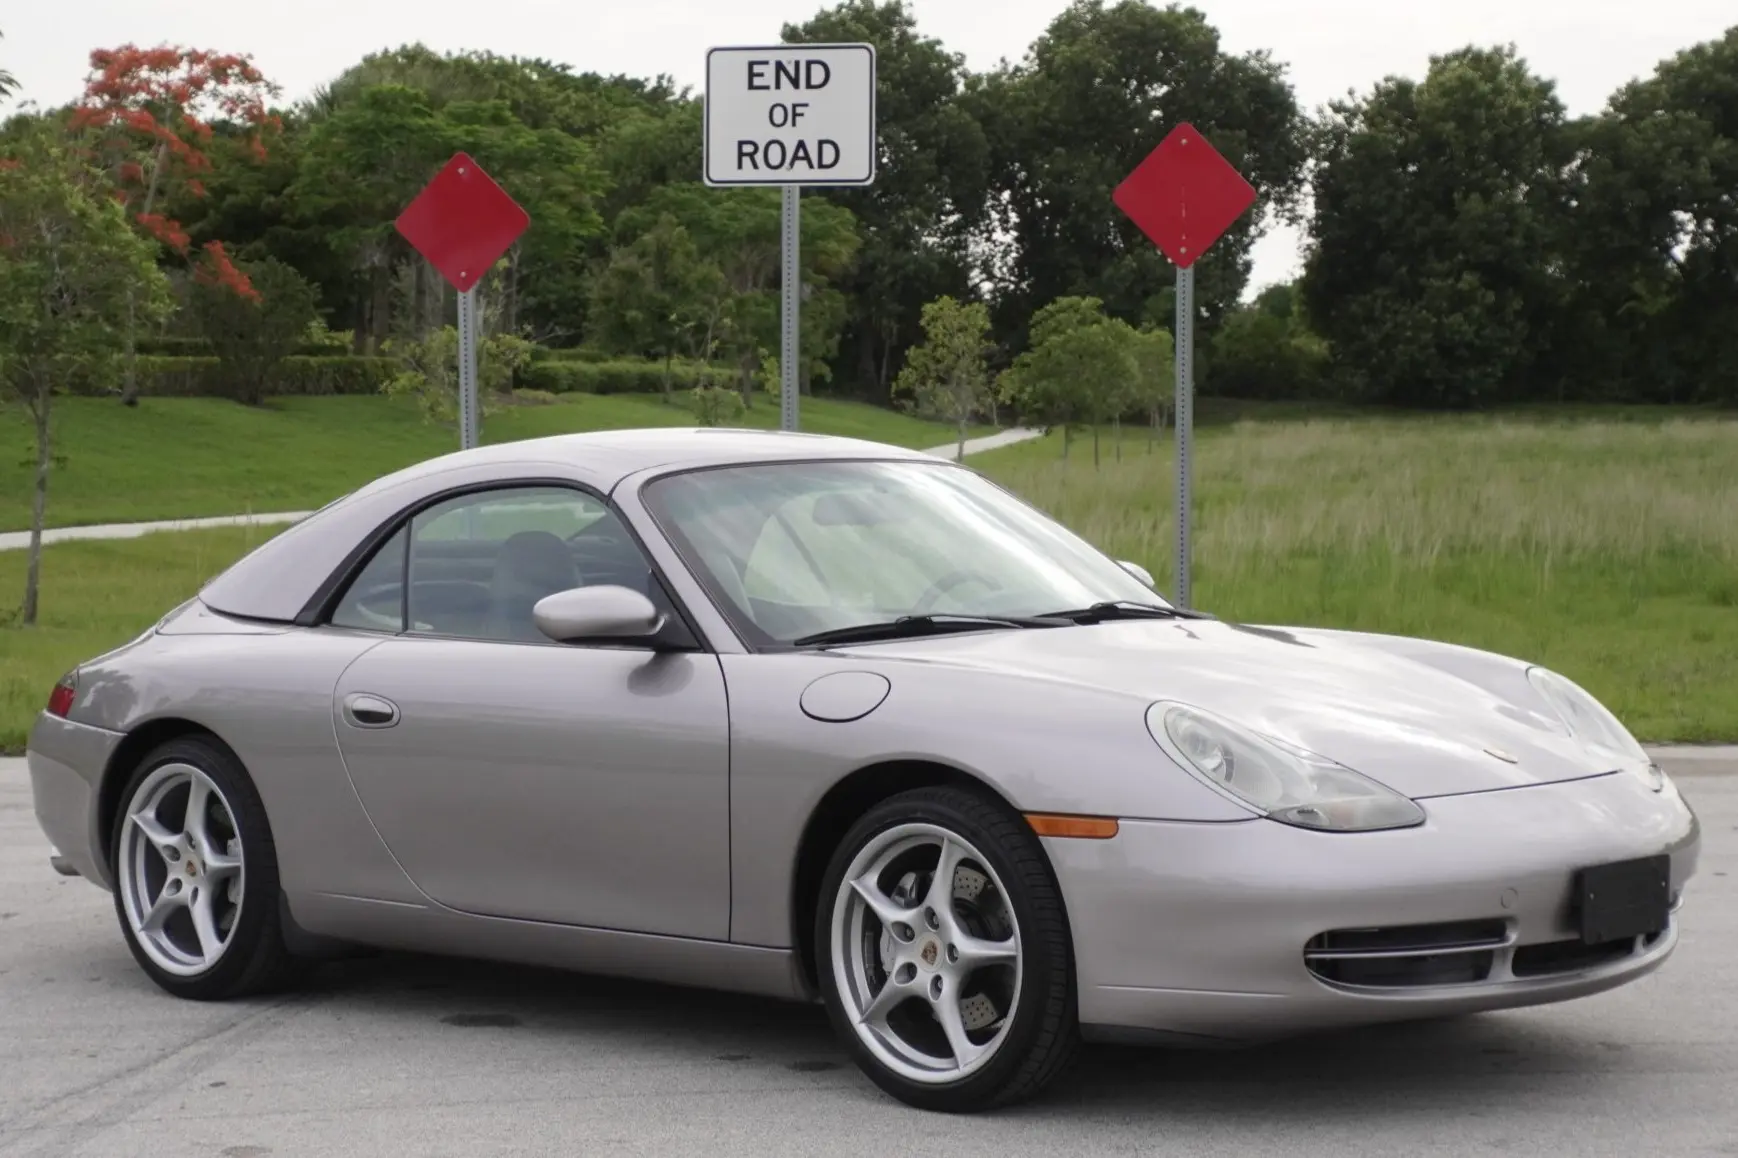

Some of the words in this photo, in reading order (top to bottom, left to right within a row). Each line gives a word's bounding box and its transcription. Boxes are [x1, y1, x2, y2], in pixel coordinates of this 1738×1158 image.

[747, 59, 831, 91] END
[768, 102, 809, 128] OF
[737, 139, 841, 171] ROAD
